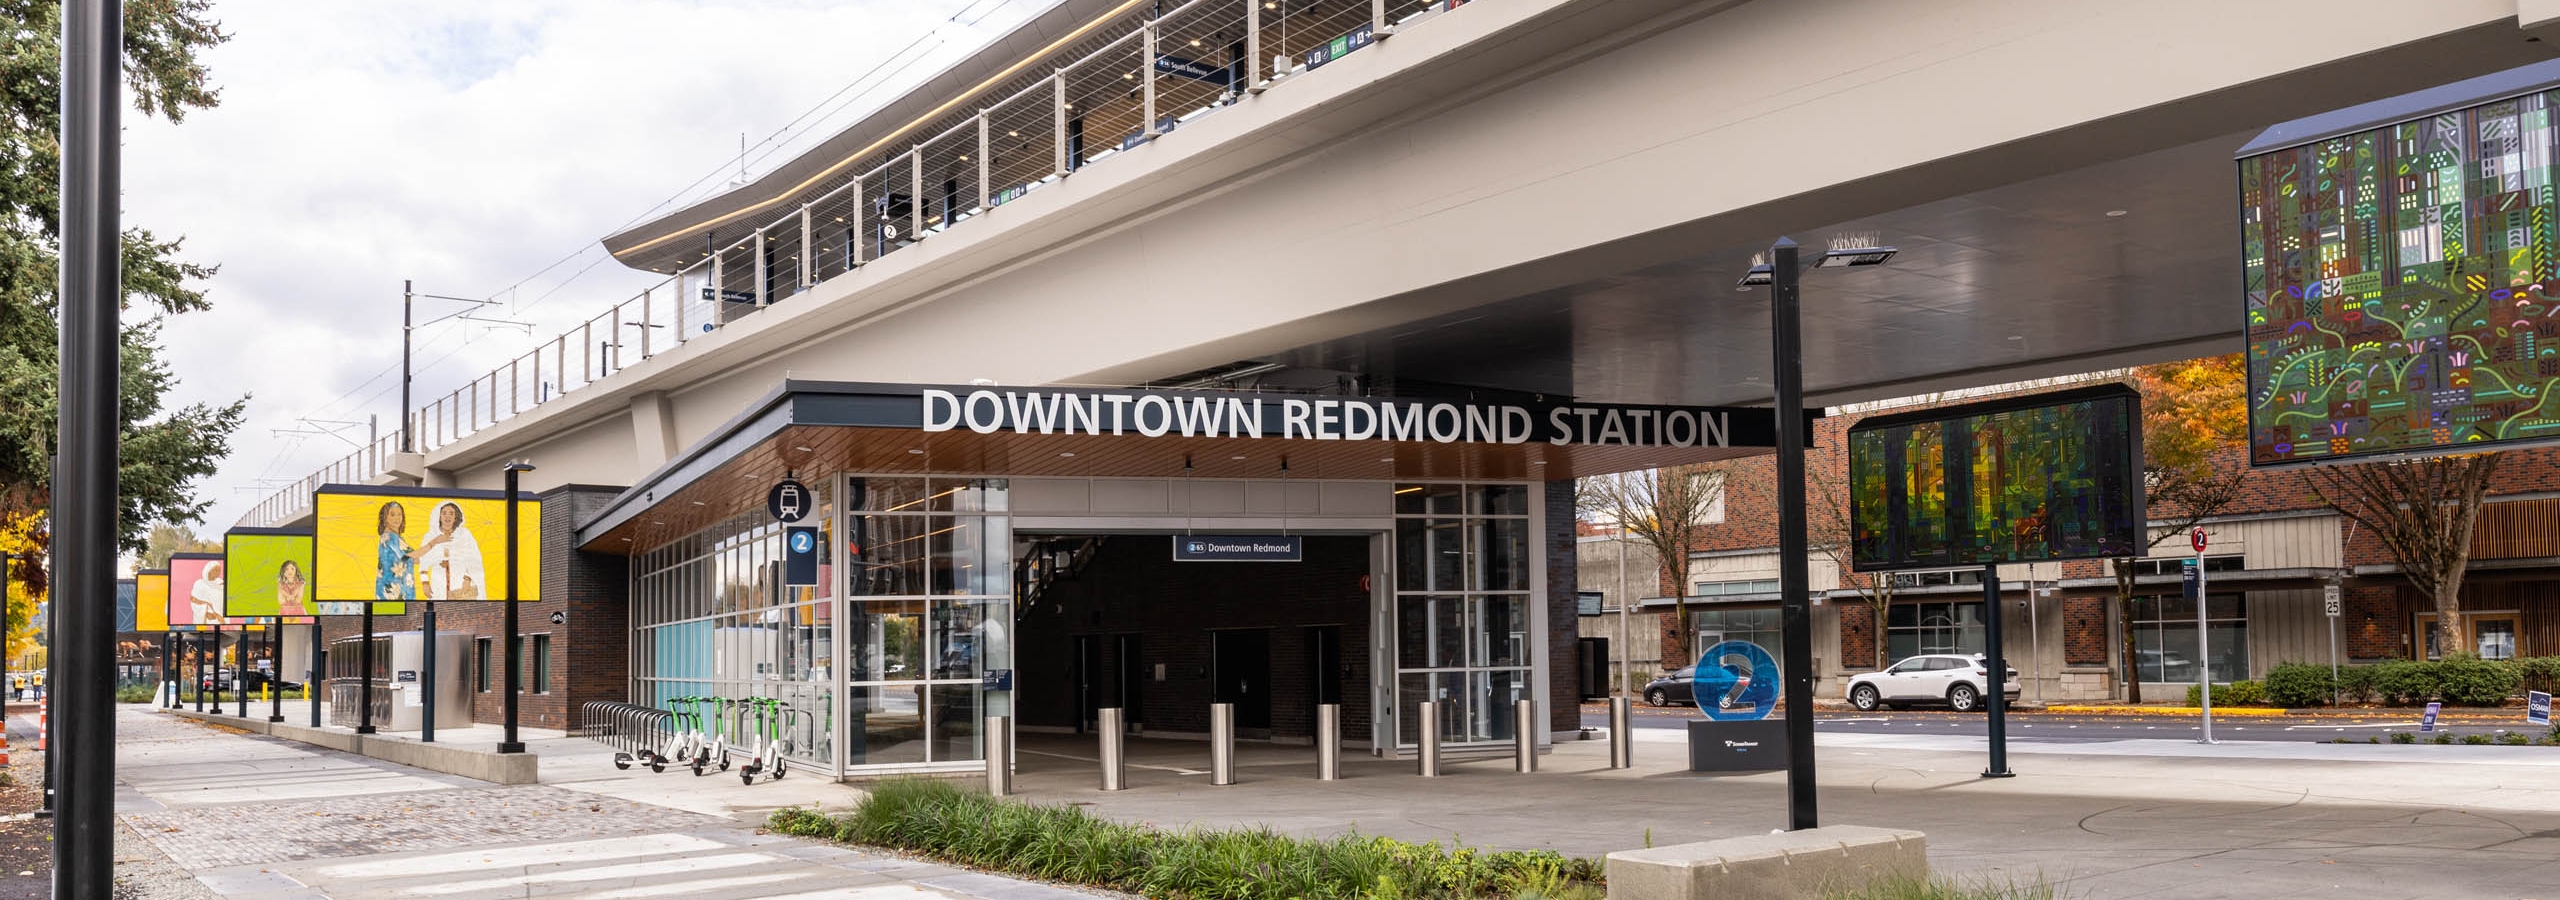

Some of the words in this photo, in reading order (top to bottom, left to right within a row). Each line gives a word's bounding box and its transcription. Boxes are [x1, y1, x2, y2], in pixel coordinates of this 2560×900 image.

[1332, 41, 1345, 55] EXIT
[1171, 61, 1186, 71] South
[1187, 66, 1207, 76] Bellevue
[888, 226, 893, 236] 2
[923, 389, 1262, 439] DOWNTOWN
[1283, 399, 1533, 444] REDMOND
[1550, 406, 1729, 448] STATION
[797, 534, 808, 550] 2
[2198, 532, 2204, 547] 2
[1208, 543, 1251, 553] Downtown
[1253, 543, 1291, 553] Redmond
[2327, 601, 2339, 613] 25
[1719, 653, 1756, 713] 2
